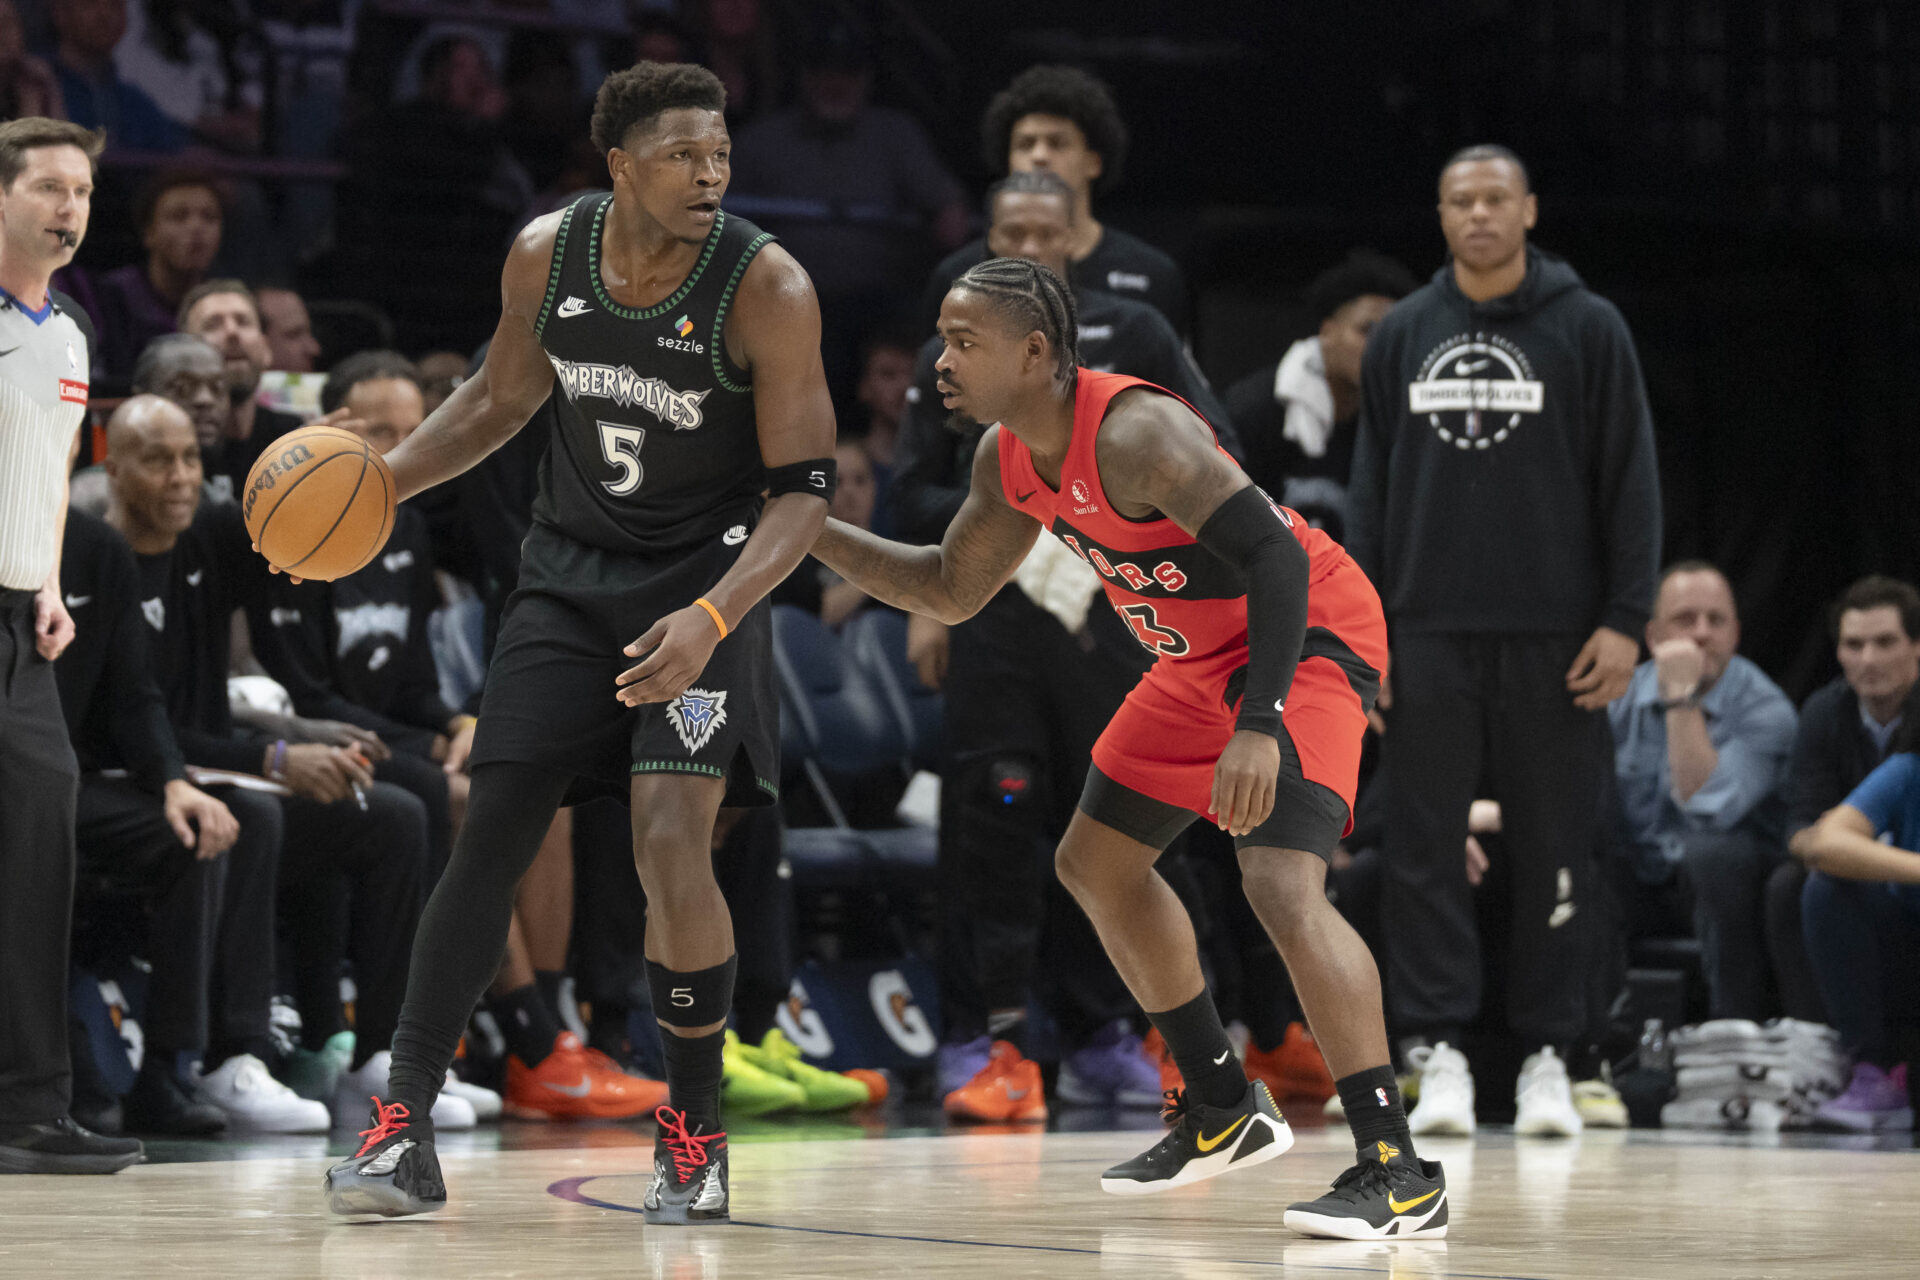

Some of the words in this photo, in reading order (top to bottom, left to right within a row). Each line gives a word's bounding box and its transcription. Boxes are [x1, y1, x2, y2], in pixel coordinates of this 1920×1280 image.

[563, 295, 587, 311] NIKE
[657, 336, 704, 354] sezzle
[544, 348, 713, 432] TIMBERWOLVES
[596, 419, 646, 496] 5
[244, 443, 315, 521] Wilson
[808, 471, 826, 488] 5
[1073, 505, 1087, 515] Sun
[1086, 503, 1099, 514] Life
[1110, 598, 1190, 657] 3
[671, 987, 694, 1007] 5
[868, 969, 938, 1058] G
